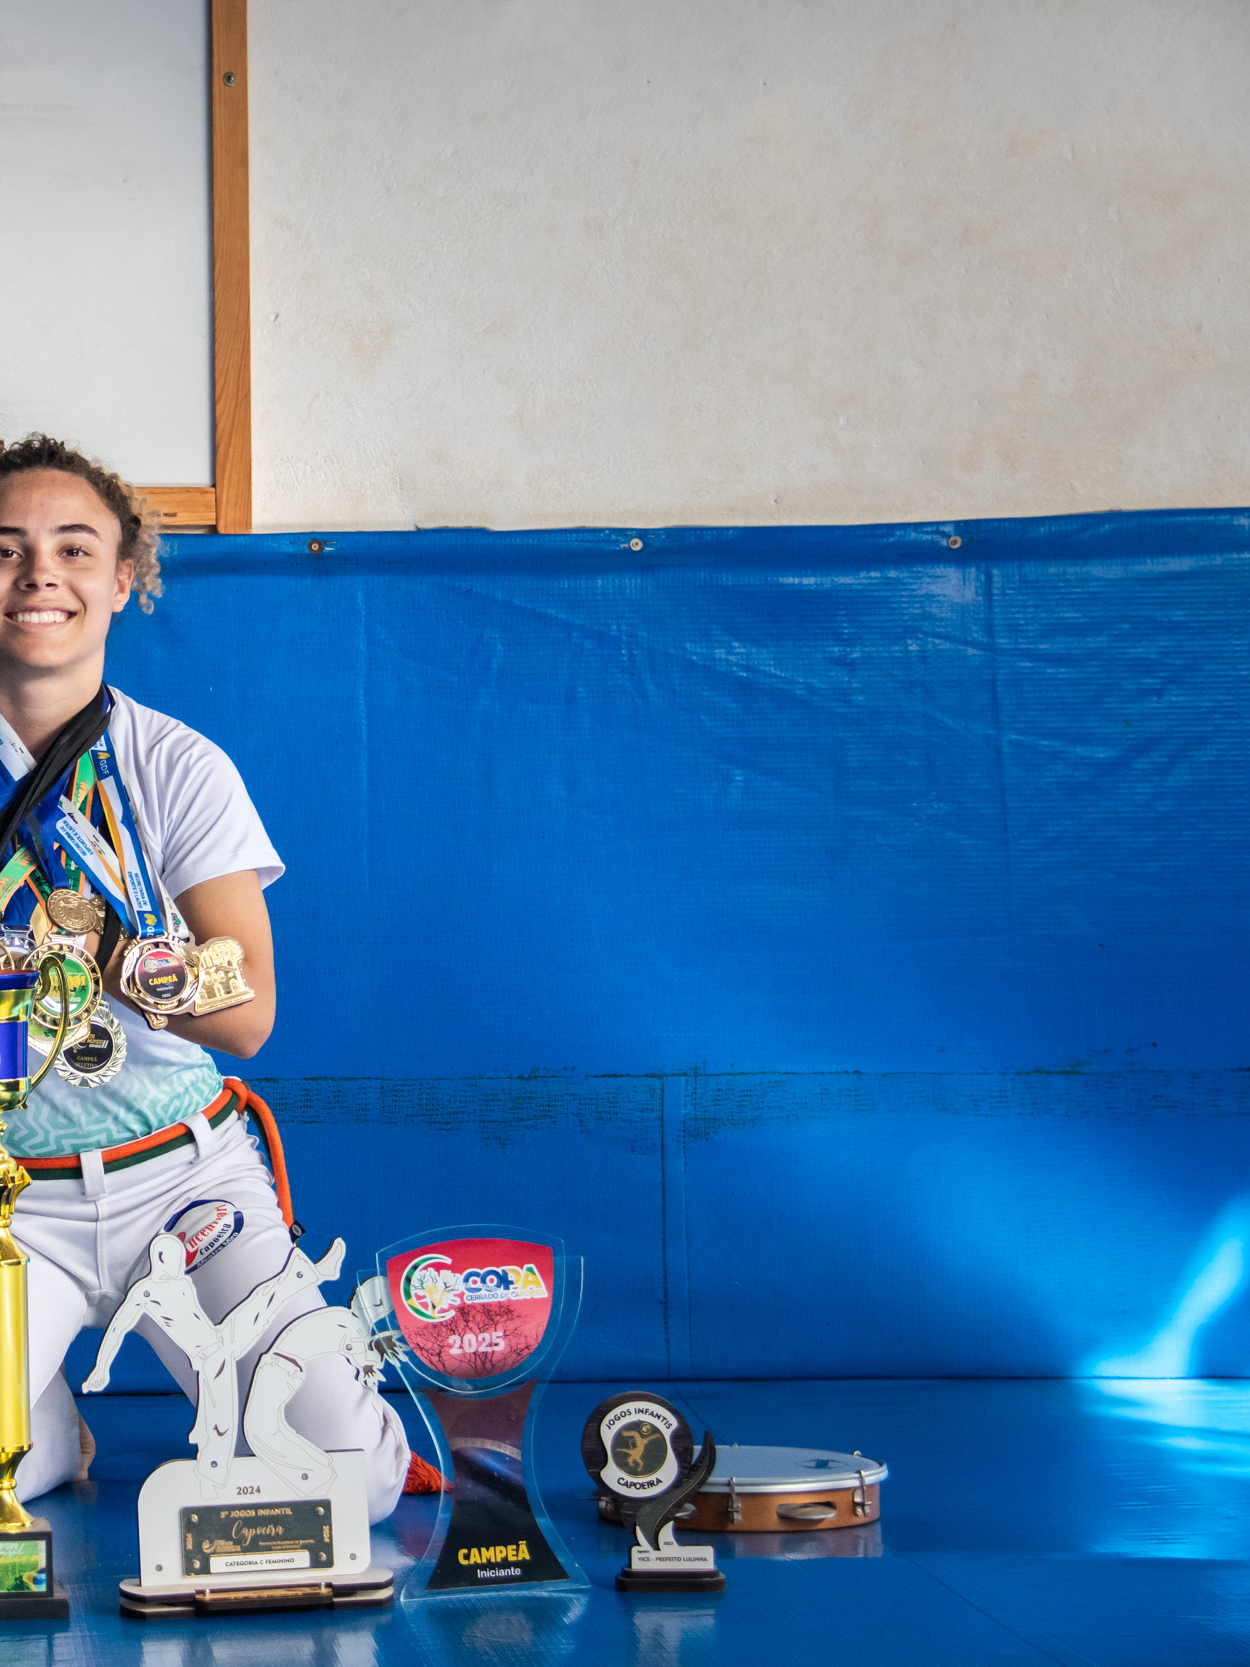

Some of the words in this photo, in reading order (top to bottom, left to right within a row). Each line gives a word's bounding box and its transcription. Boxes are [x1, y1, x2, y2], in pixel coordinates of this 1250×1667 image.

[99, 760, 110, 776] GDF
[127, 871, 137, 890] ESPORTE
[134, 894, 143, 909] LAZER
[134, 873, 146, 898] SECRETARIA
[148, 973, 179, 986] CAMPEÃ
[199, 1223, 232, 1256] Capoeira
[462, 1267, 544, 1294] COPA
[466, 1293, 499, 1302] CERRADO
[448, 1331, 506, 1355] 2025
[605, 1408, 632, 1430] JOGOS
[633, 1407, 673, 1430] INFANTIS
[236, 1485, 261, 1496] 2024
[617, 1476, 664, 1490] CAPOEIRA
[230, 1510, 256, 1518] JOGOS
[257, 1507, 293, 1517] INFANTIL
[232, 1520, 285, 1547] Capoeira
[225, 1559, 259, 1567] CATEGORIA
[265, 1557, 295, 1565] FEMININO
[457, 1540, 531, 1565] CAMPEÃ
[477, 1567, 521, 1578] Iniciante
